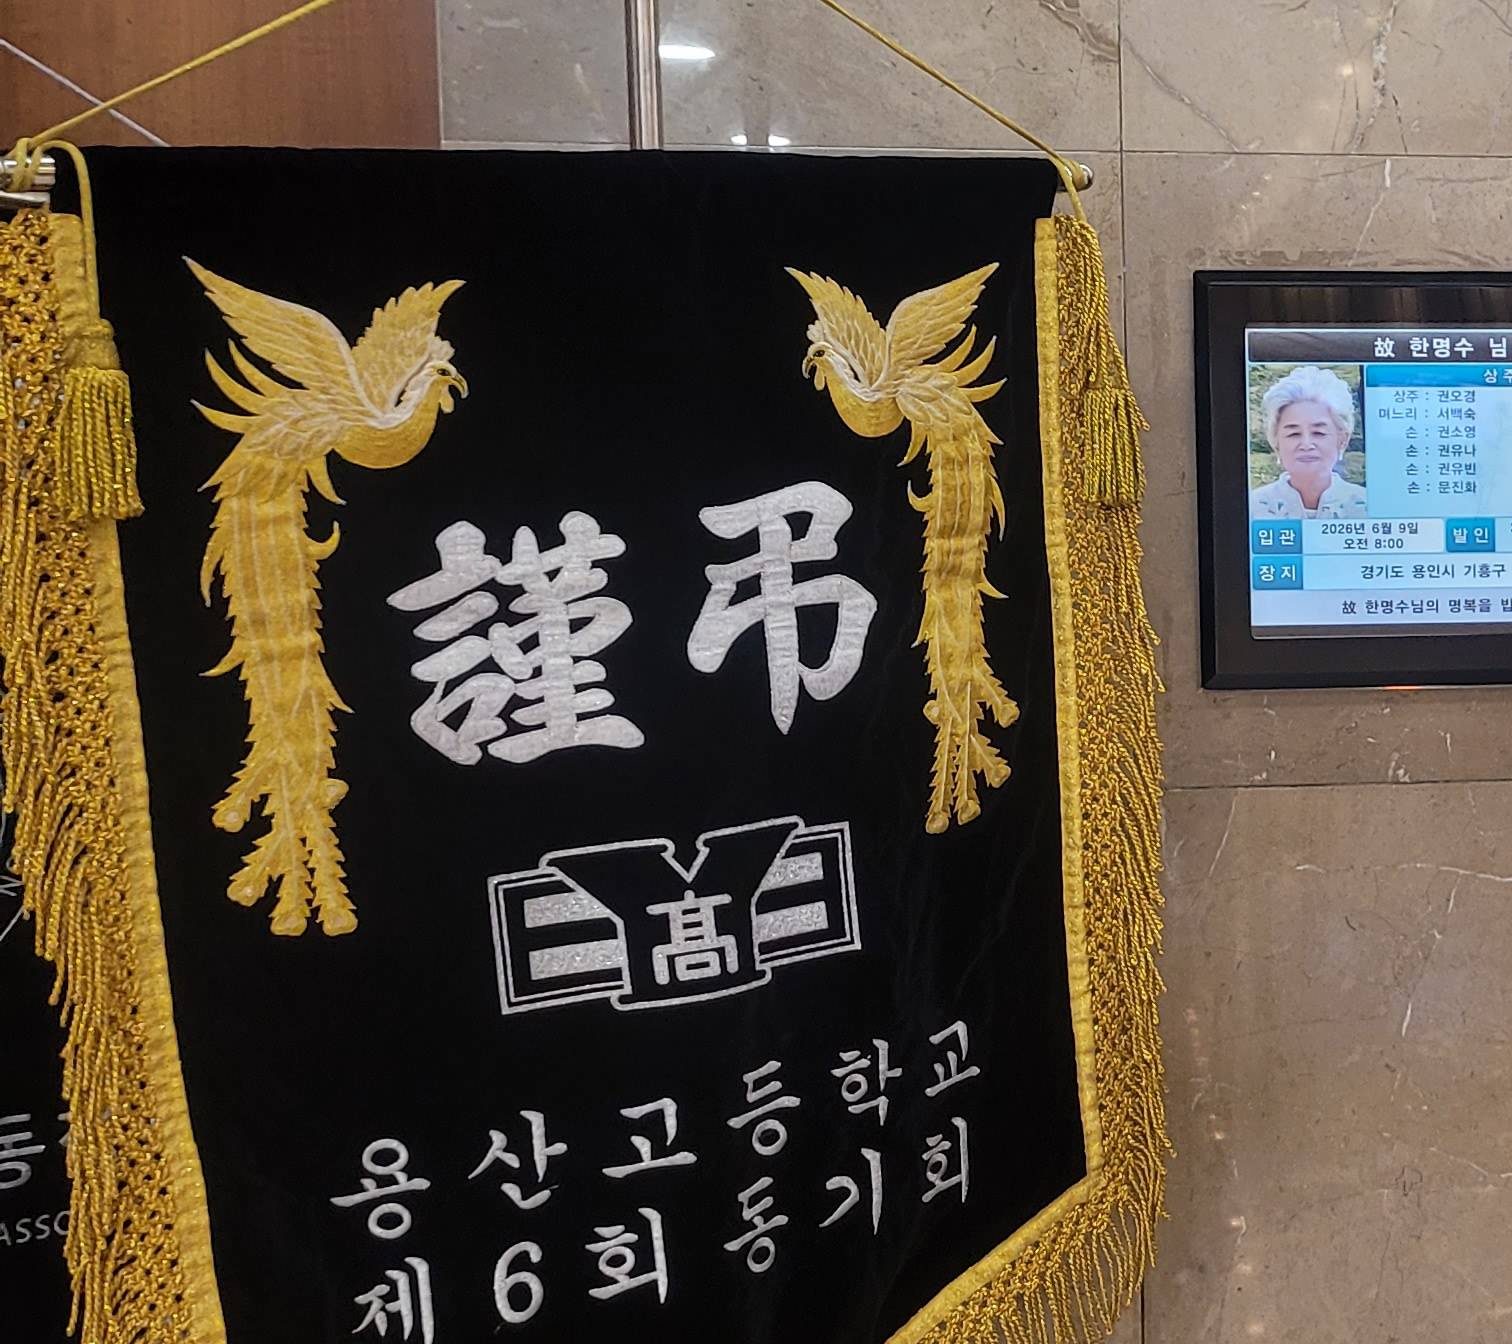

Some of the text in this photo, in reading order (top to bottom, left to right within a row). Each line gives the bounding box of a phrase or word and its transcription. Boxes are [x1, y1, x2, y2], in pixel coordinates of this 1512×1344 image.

[1374, 337, 1508, 357] 故 한명수 님
[1394, 390, 1419, 403] 상주
[1437, 390, 1476, 403] 권오경
[1378, 407, 1417, 420] 며느리
[1437, 407, 1476, 421] 서백숙
[1405, 426, 1418, 439] 손
[1438, 426, 1476, 439] 권소영
[1405, 444, 1418, 457] 손
[1438, 444, 1477, 457] 권유나
[1405, 463, 1418, 476] 손
[1438, 463, 1477, 476] 권유빈
[1407, 482, 1420, 494] 손
[1438, 481, 1477, 494] 문진화
[1321, 522, 1419, 535] 2026년 6월 9일
[1258, 529, 1296, 546] 입관
[1452, 527, 1489, 544] 발인
[1343, 538, 1404, 550] 오전 8:00
[1258, 565, 1296, 581] 장지
[1360, 565, 1404, 579] 경기도
[1412, 564, 1455, 579] 용인시
[1464, 563, 1506, 578] 기흥구
[1342, 600, 1357, 614] 故
[1365, 599, 1440, 614] 한명수님의
[1448, 598, 1492, 613] 명복을
